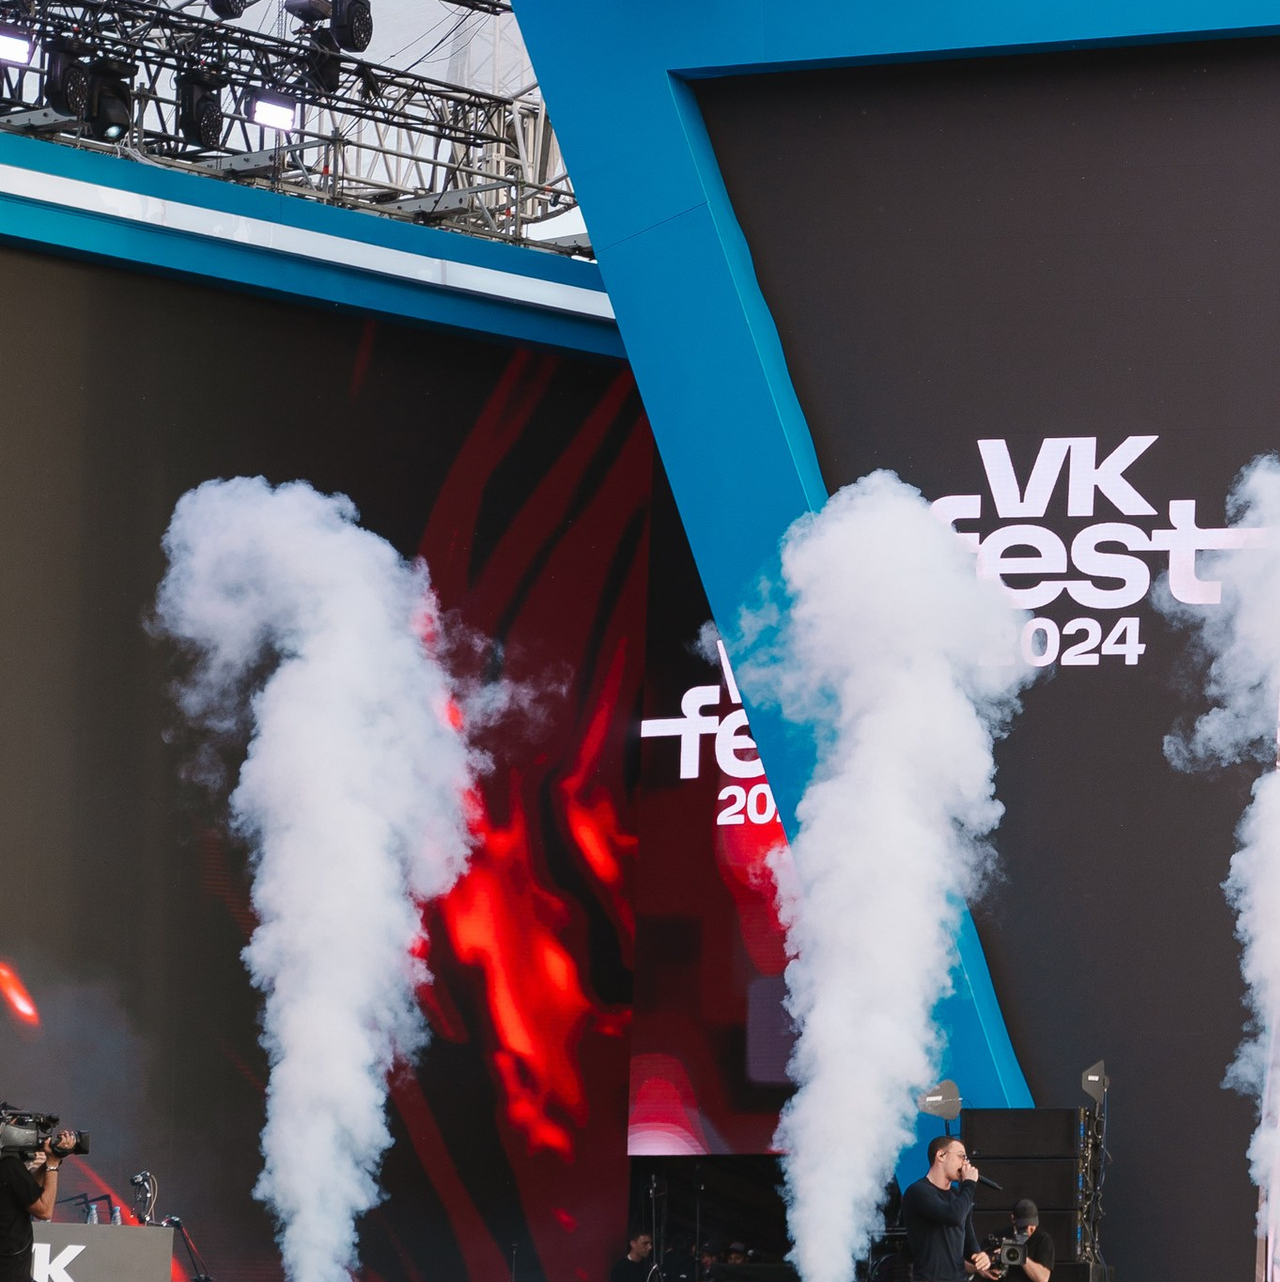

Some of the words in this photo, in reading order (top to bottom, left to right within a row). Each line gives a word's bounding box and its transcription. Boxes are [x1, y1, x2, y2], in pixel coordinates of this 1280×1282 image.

[977, 435, 1159, 519] VK
[978, 616, 1147, 668] 024
[641, 685, 766, 779] fe
[716, 783, 783, 826] 20
